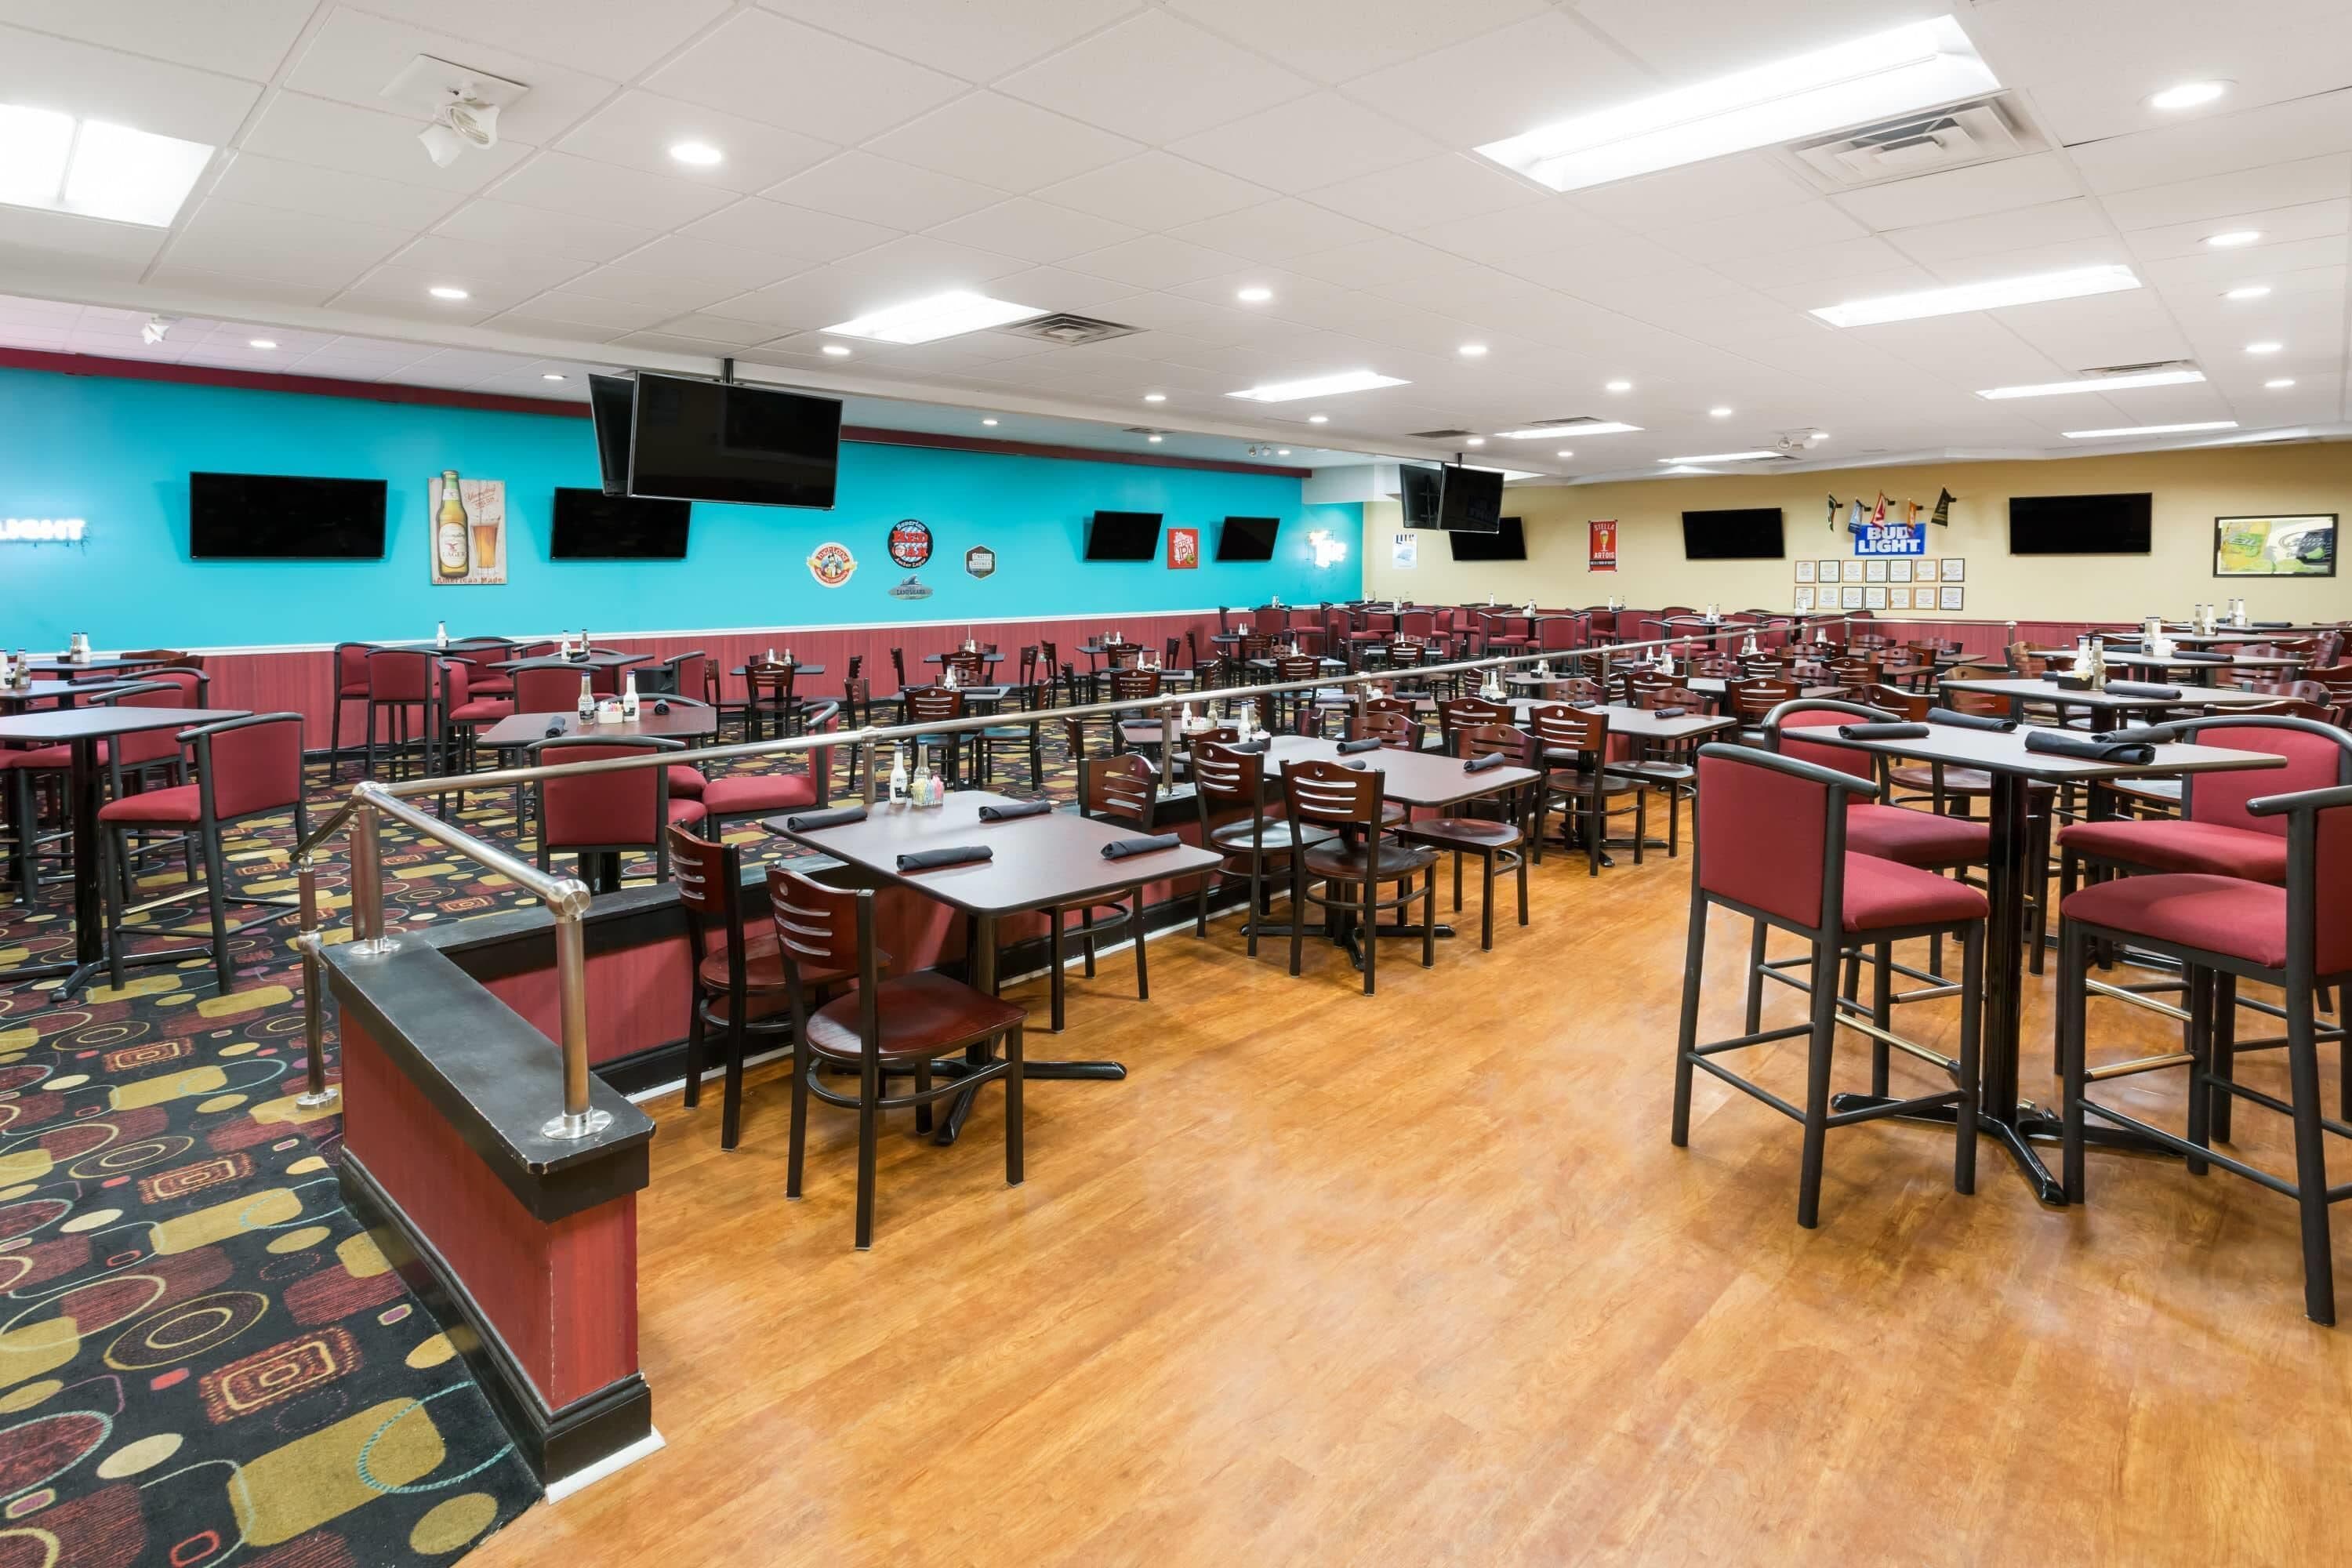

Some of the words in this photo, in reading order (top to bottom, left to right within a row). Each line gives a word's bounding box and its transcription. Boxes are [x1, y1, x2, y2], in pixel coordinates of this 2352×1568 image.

[892, 531, 928, 543] RED
[1867, 526, 1910, 539] BUD
[1179, 544, 1194, 559] IPA
[1858, 539, 1921, 553] LIGHT
